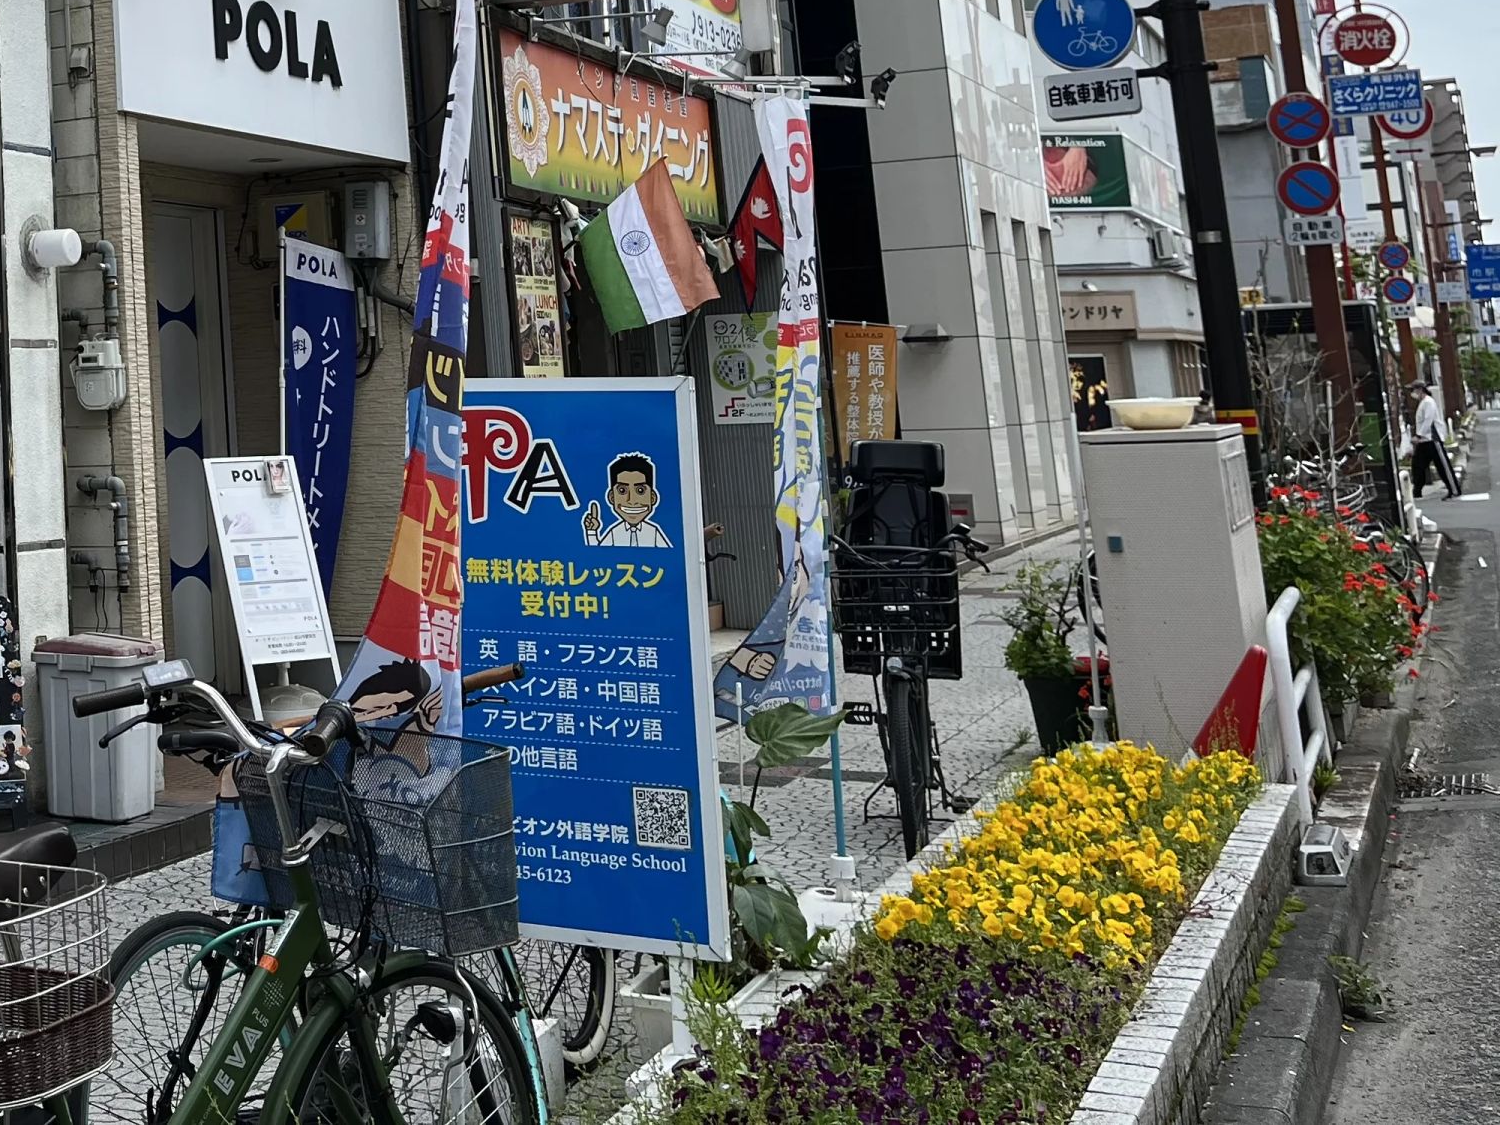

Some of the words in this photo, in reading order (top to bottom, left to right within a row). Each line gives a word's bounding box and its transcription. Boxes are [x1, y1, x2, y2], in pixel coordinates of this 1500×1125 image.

[1338, 28, 1392, 51] 消火栓
[1048, 76, 1134, 108] 自転車通行可
[1333, 83, 1417, 105] さくらクリニック
[1055, 136, 1107, 148] Relaxation
[296, 252, 338, 280] POLA
[534, 294, 559, 311] LUNCH
[866, 343, 886, 441] 医師や教授が
[731, 409, 746, 418] 2F
[231, 468, 268, 483] POL
[465, 557, 665, 588] 無料体験レッスン
[520, 590, 610, 620] 受付中!
[482, 708, 663, 742] アラビア語・ドイツ語
[549, 844, 628, 868] Language
[631, 853, 687, 873] School
[251, 1007, 270, 1028] PLUS
[213, 1026, 264, 1096] EVA
